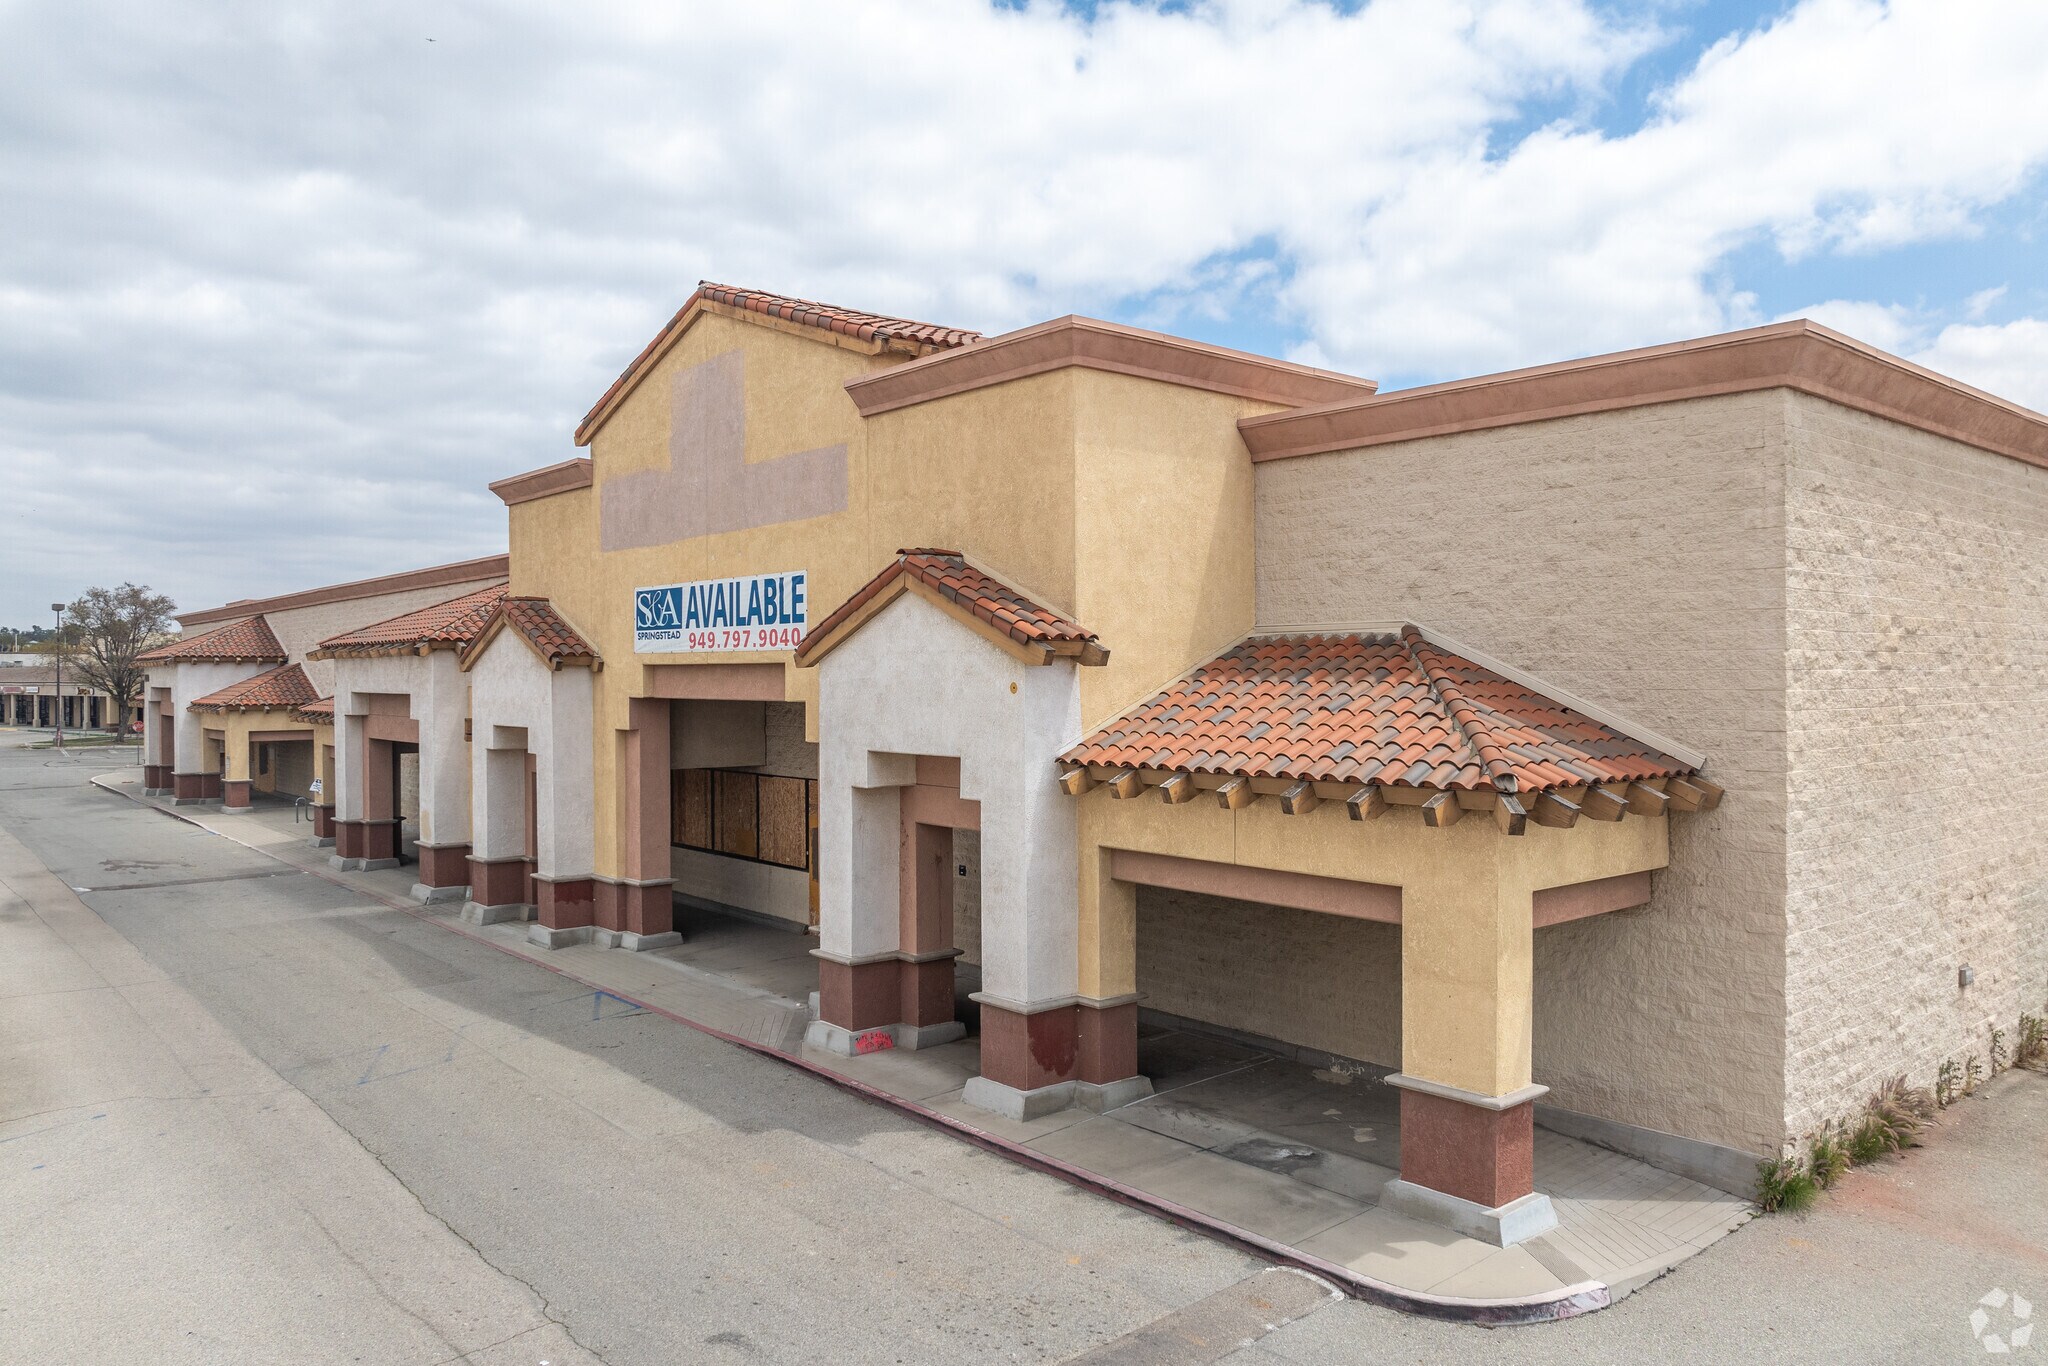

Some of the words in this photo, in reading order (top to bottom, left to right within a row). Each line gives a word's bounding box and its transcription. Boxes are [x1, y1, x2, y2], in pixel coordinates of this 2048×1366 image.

[685, 575, 804, 629] AVAILABLE
[637, 630, 681, 641] SPRINGSTEAD
[689, 627, 801, 649] 949.797.9040
